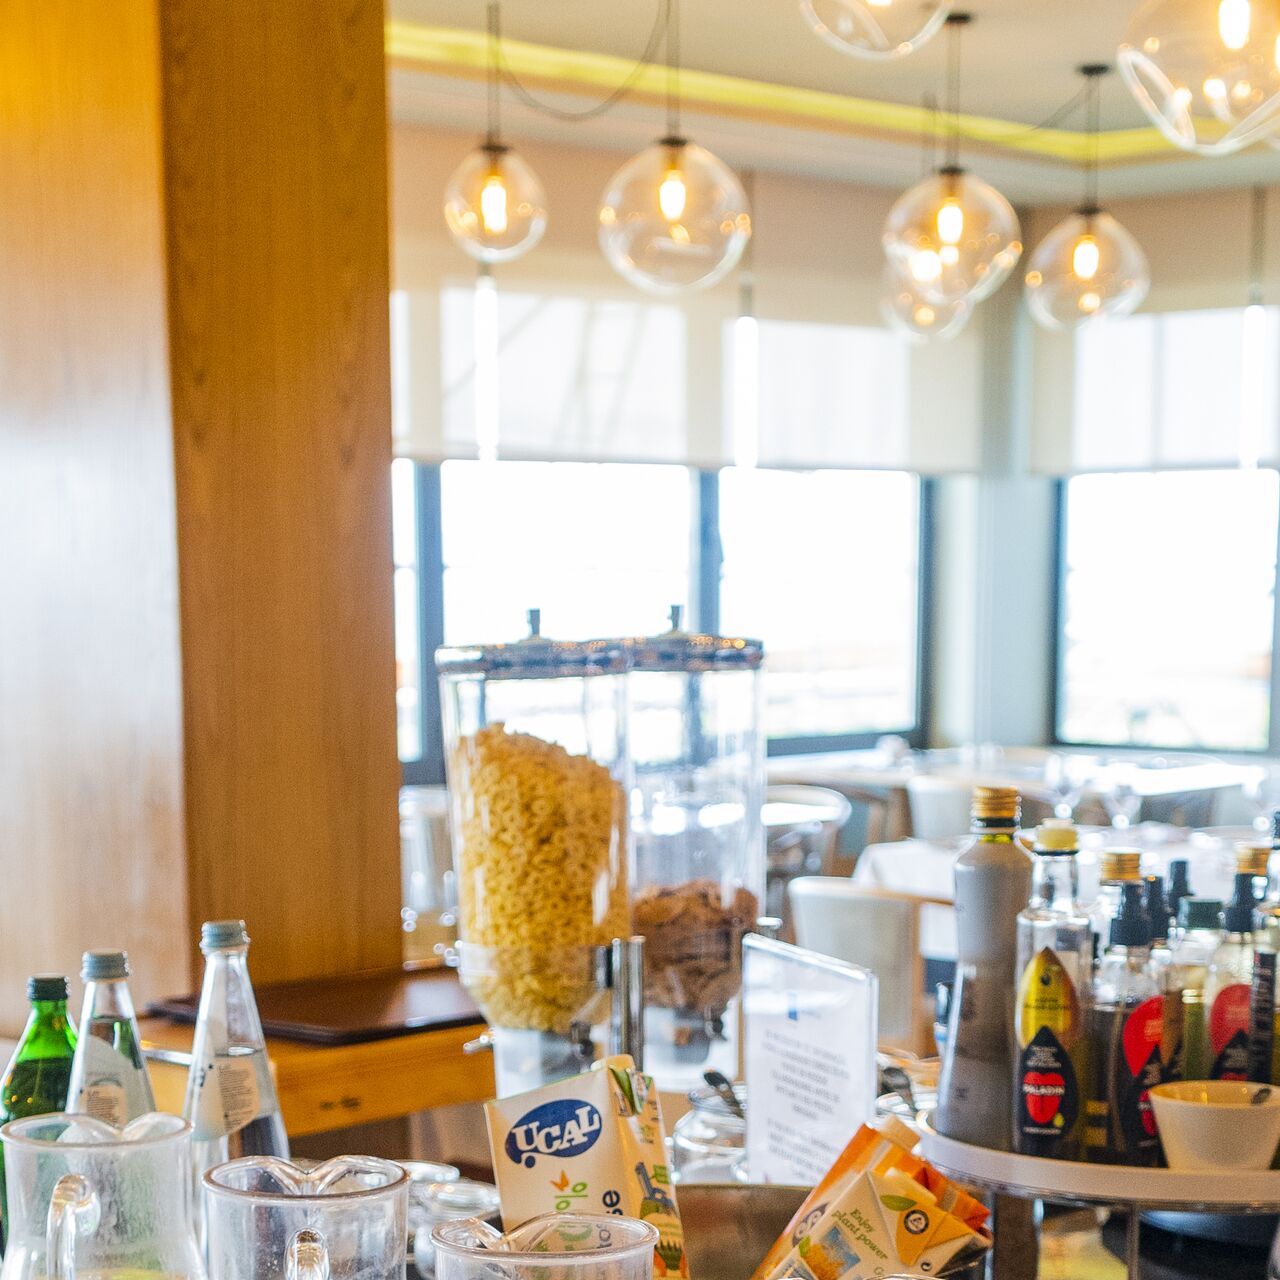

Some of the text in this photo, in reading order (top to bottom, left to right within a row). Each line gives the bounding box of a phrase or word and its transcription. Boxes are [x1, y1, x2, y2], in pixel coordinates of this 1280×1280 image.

[511, 1105, 600, 1154] UCAL
[831, 1209, 862, 1240] plant
[856, 1232, 889, 1261] power
[850, 1208, 877, 1233] Enjoy
